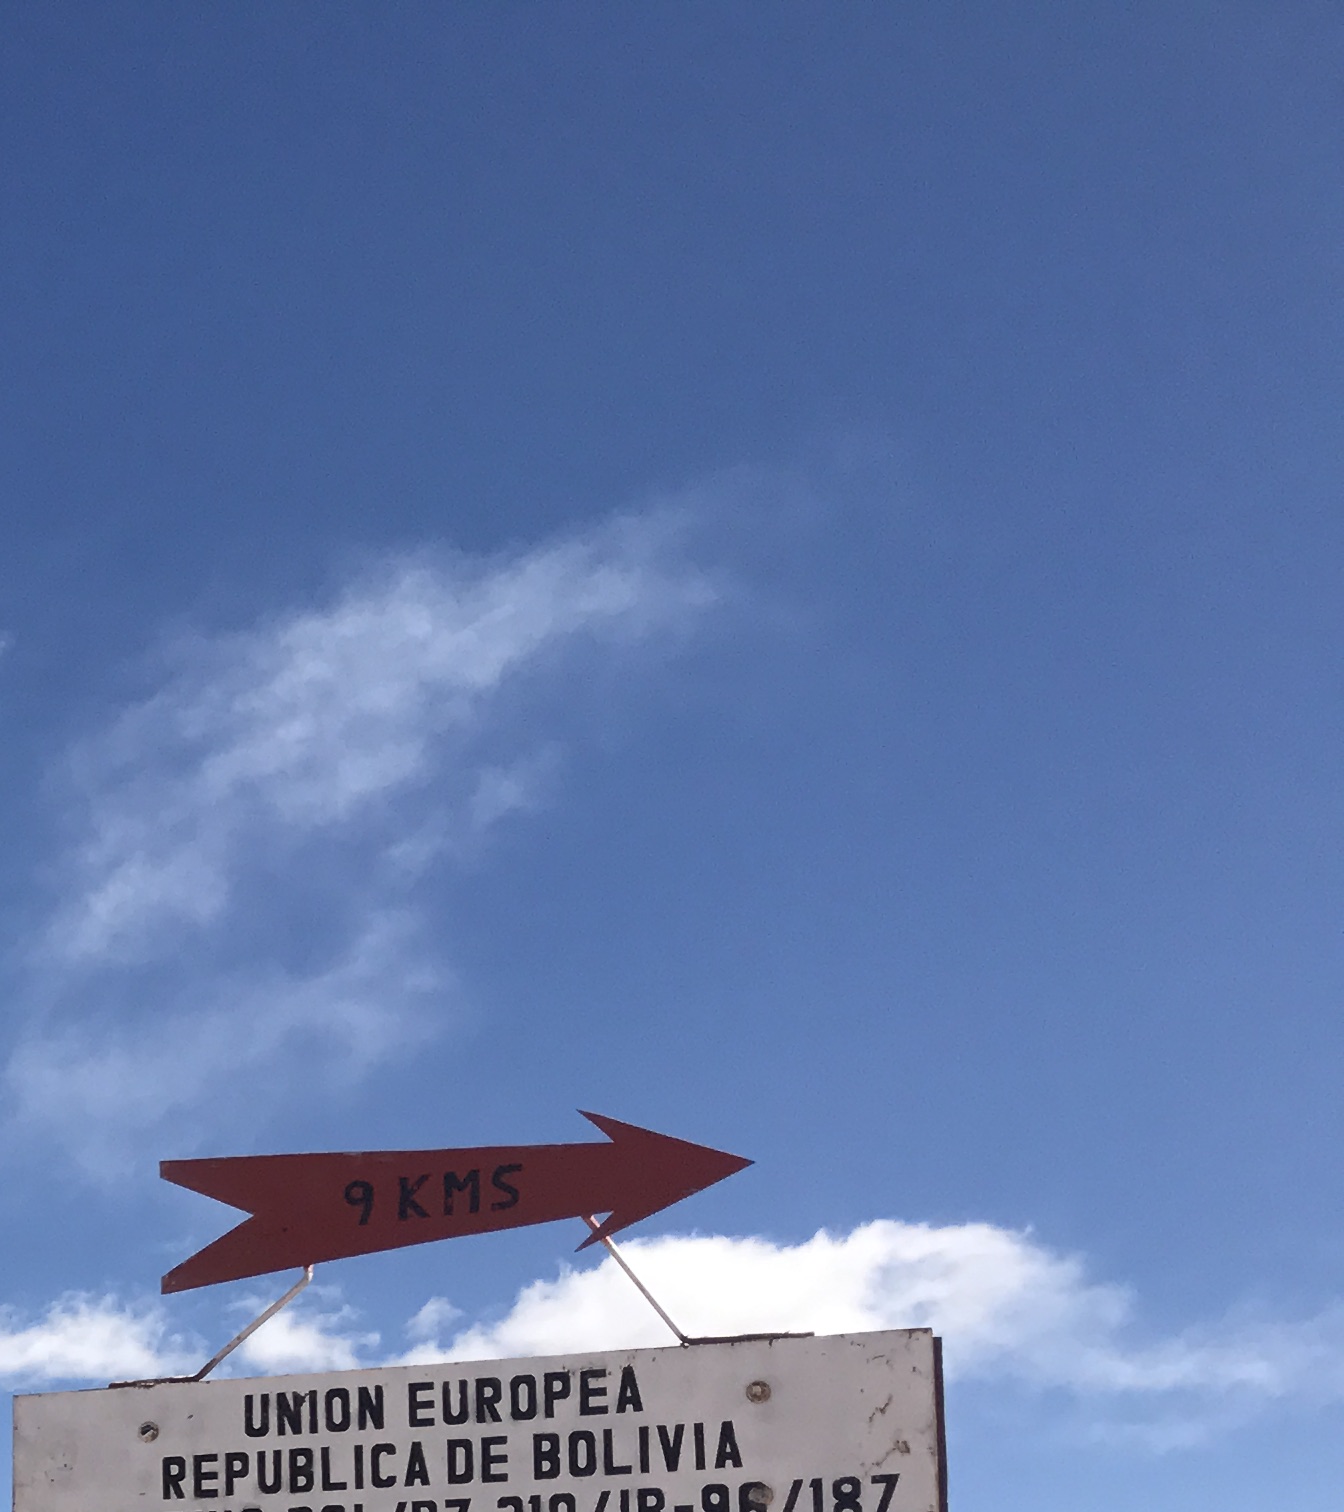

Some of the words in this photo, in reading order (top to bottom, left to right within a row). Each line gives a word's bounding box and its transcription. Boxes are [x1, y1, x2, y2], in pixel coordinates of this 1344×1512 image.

[344, 1180, 374, 1226] 9
[397, 1163, 523, 1221] KMS
[244, 1384, 384, 1438] UNION
[408, 1364, 644, 1428] EUROPEA
[162, 1441, 430, 1499] REPUBLICA
[447, 1435, 509, 1485] DE
[532, 1420, 744, 1481] BOLIVIA
